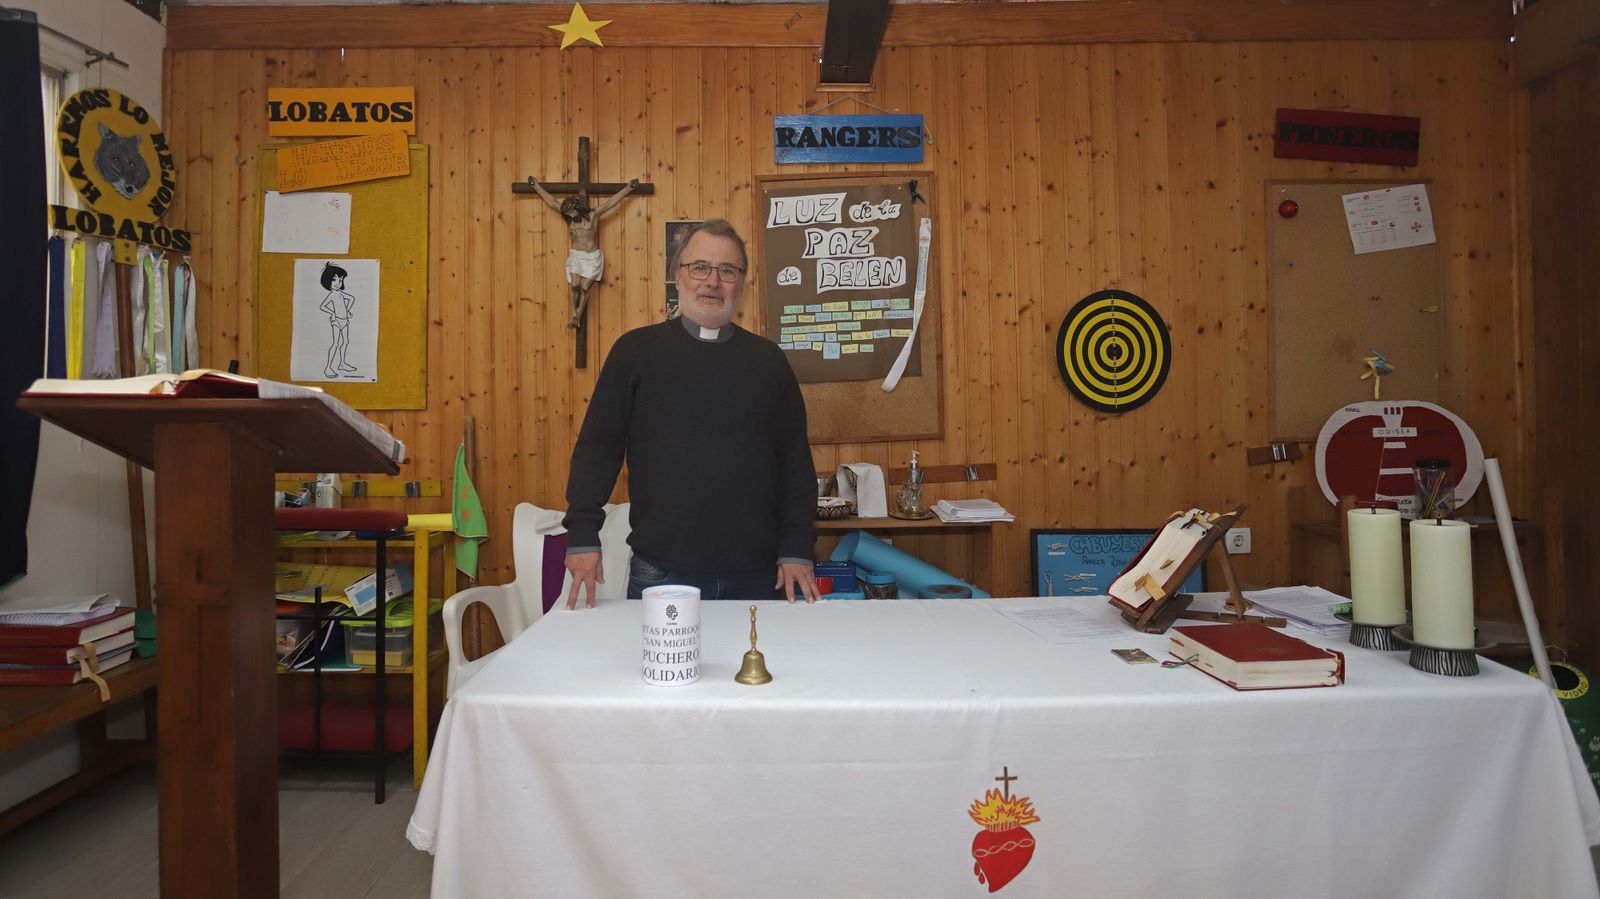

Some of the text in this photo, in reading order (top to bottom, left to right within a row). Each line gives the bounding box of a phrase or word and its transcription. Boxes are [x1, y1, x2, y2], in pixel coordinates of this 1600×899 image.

[268, 101, 413, 123] LOBATOS
[775, 126, 921, 148] RANGERS
[1279, 121, 1420, 152] PIONEROS
[58, 89, 175, 217] HAREMOS LO MEJOR
[290, 133, 396, 169] HAREMOS
[279, 151, 410, 189] LO MEJOR
[773, 198, 838, 225] LUZ
[852, 202, 872, 220] de
[51, 205, 193, 252] LOBATOS
[805, 229, 872, 255] PAZ
[778, 266, 799, 285] de
[819, 259, 903, 288] BELEN
[643, 648, 699, 664] PUCHERO
[642, 665, 700, 681] OLIDARIO
